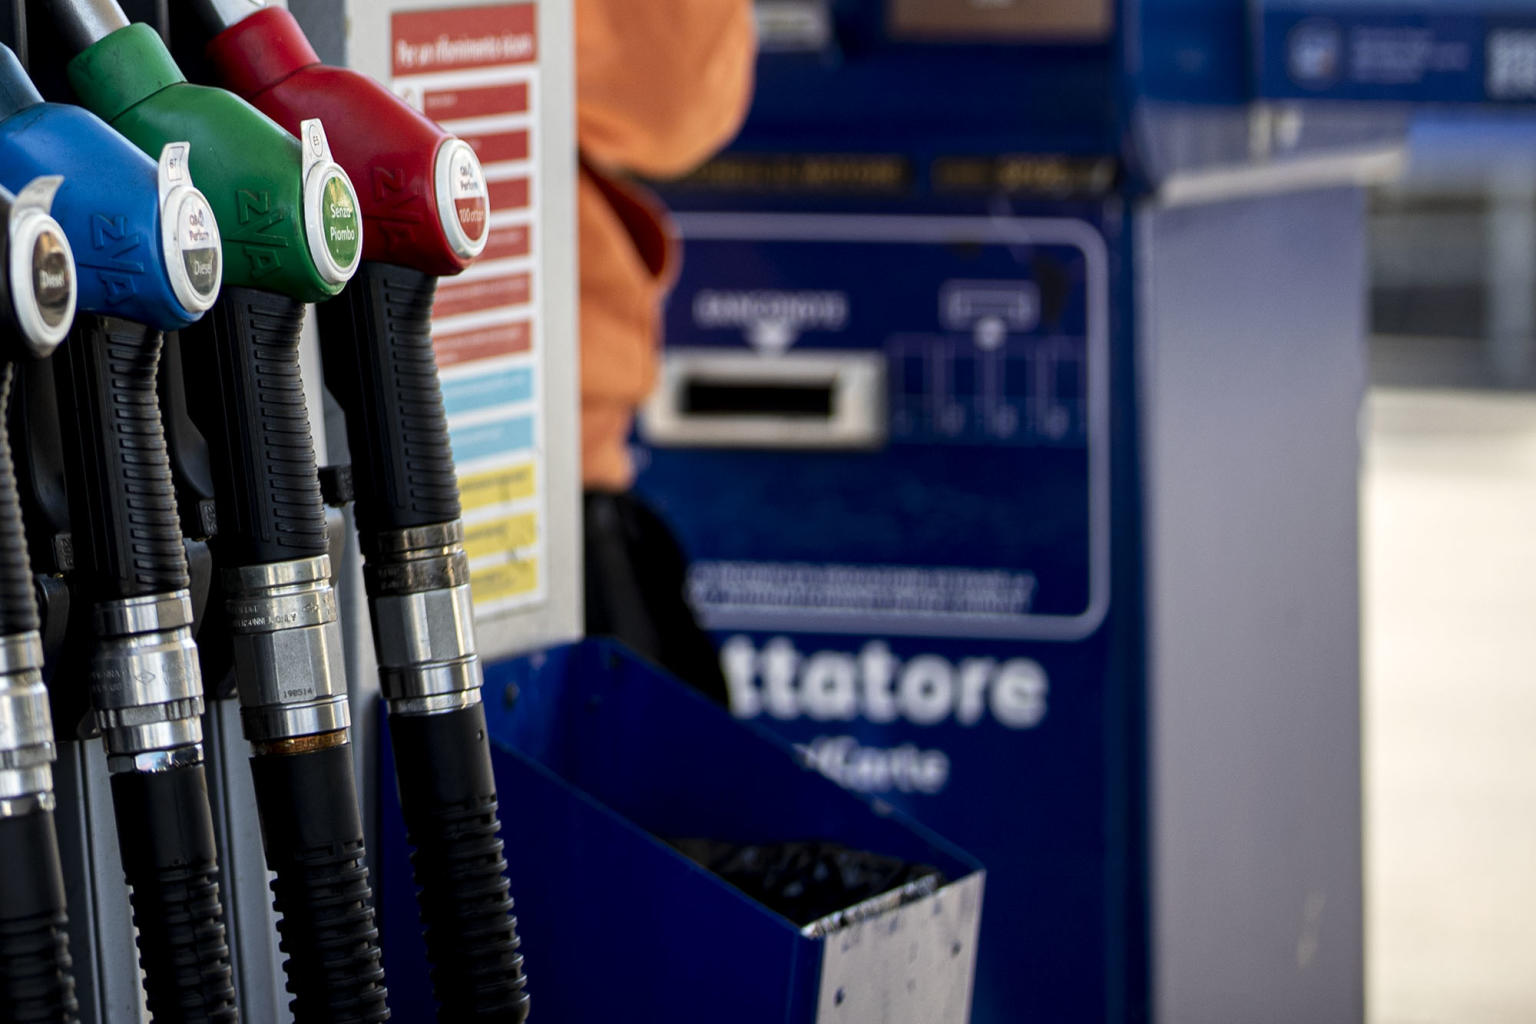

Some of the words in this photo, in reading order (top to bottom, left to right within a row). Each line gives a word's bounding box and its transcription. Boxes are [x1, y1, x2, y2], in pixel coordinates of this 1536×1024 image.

[330, 204, 352, 219] Senza
[330, 225, 355, 242] Piombo
[194, 259, 213, 276] Diesel
